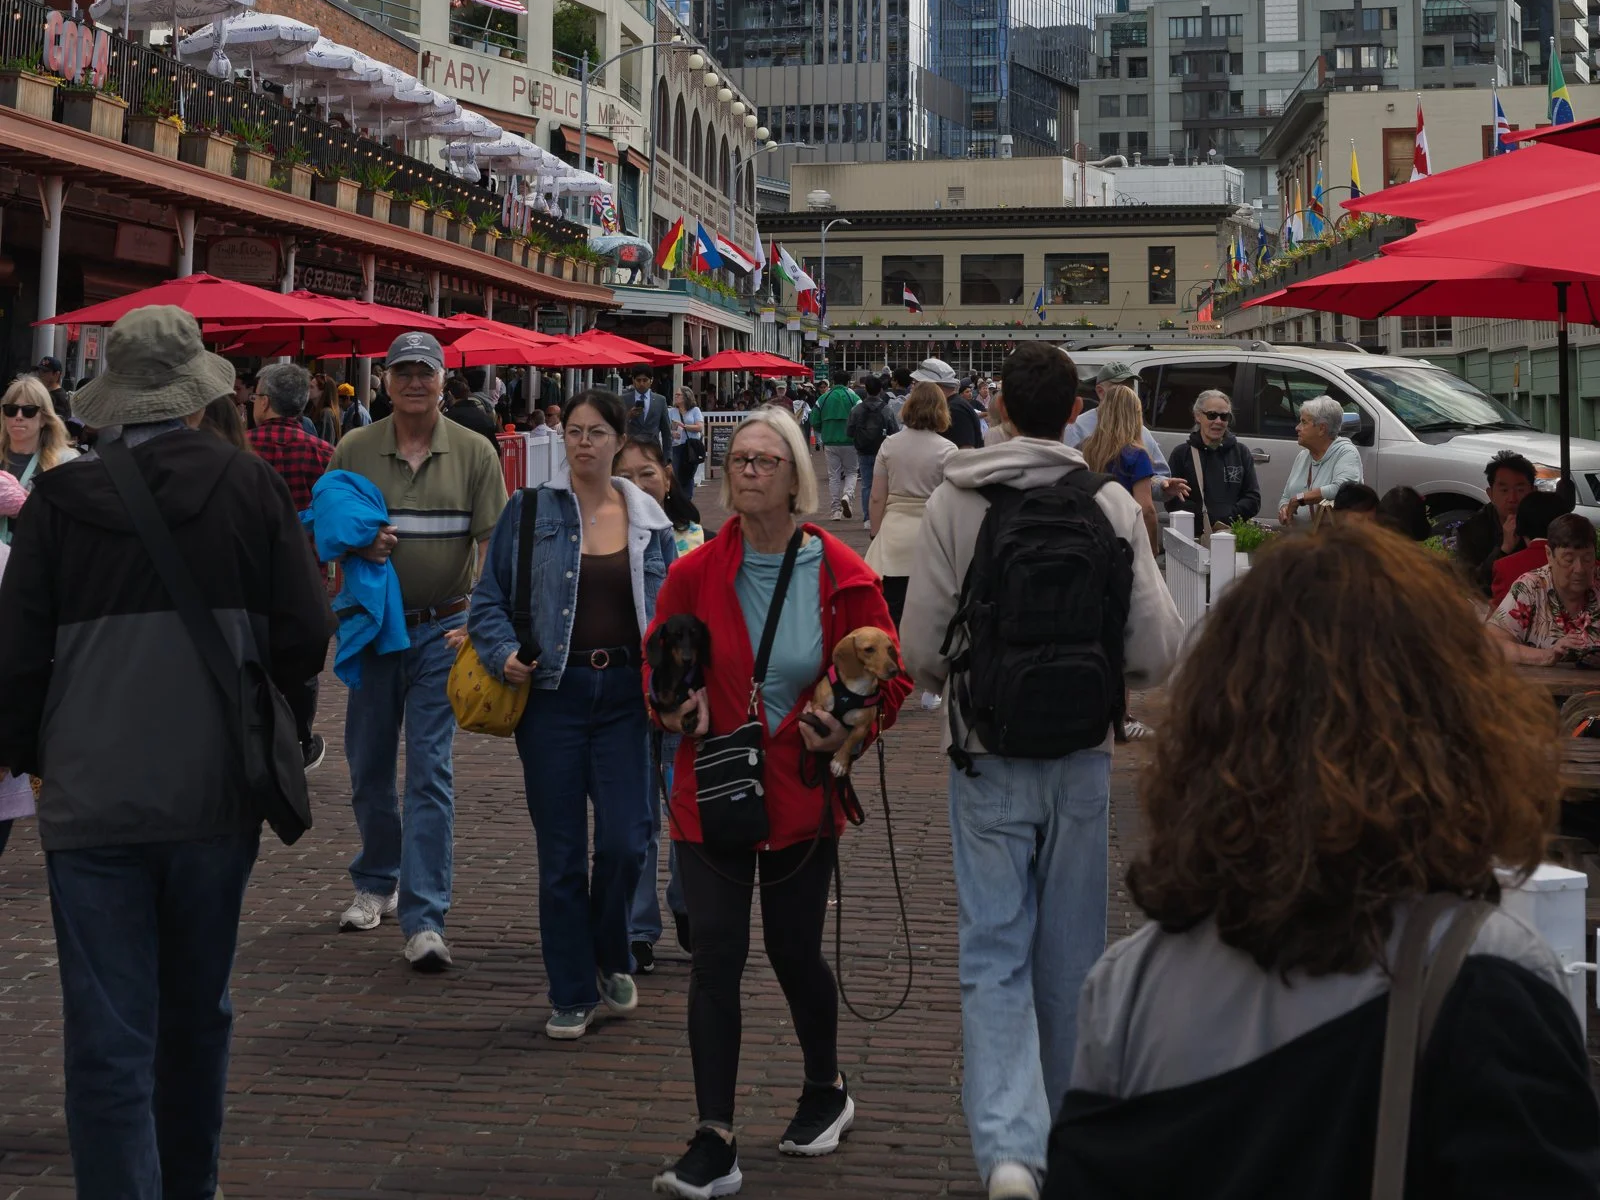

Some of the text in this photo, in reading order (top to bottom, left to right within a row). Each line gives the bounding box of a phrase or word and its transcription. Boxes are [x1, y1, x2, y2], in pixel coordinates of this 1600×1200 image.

[43, 10, 108, 89] COPA
[512, 75, 579, 119] PUBLIC
[303, 266, 355, 294] GREEK
